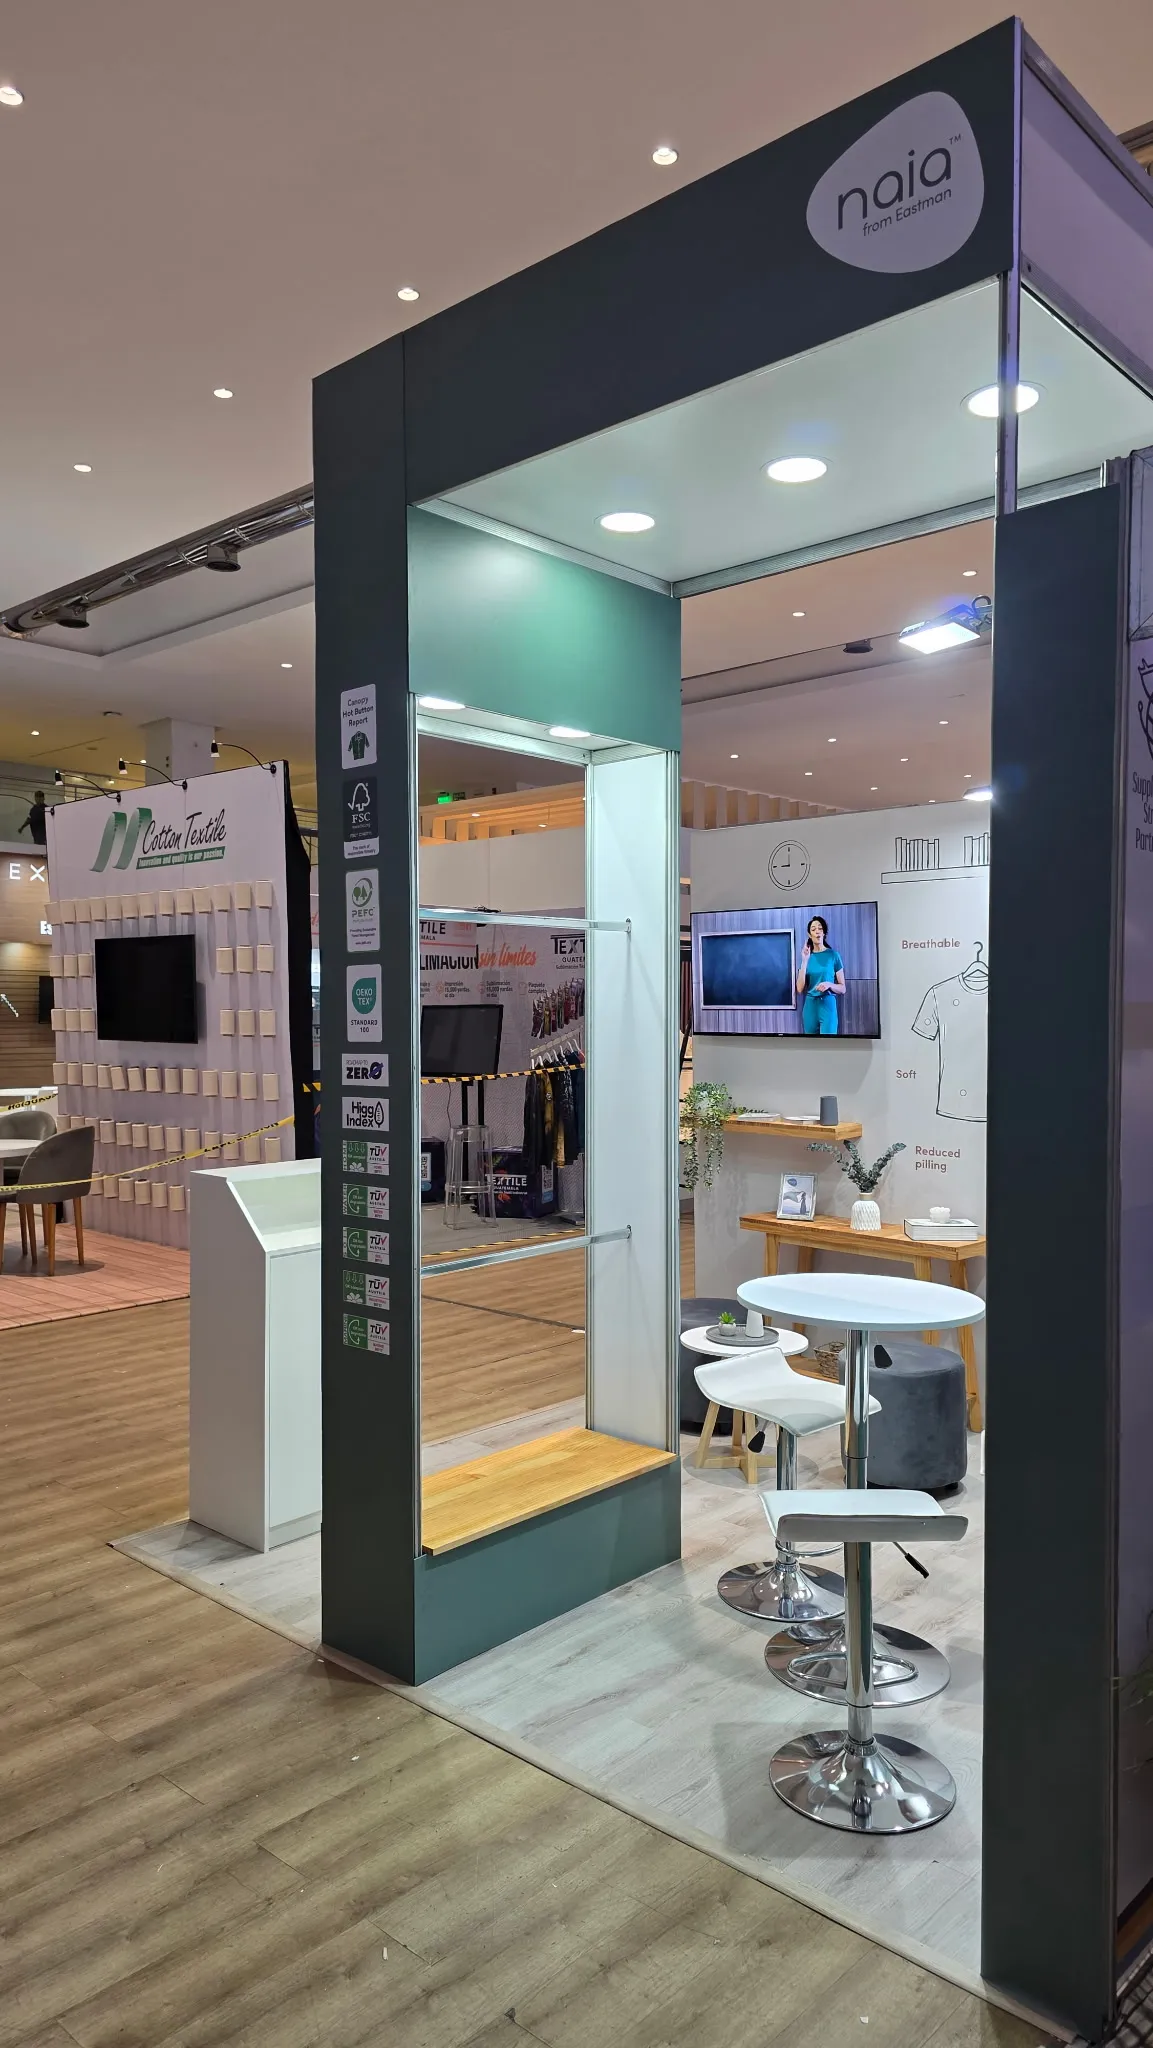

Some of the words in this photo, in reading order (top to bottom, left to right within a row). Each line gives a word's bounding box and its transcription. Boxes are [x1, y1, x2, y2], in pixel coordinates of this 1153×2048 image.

[863, 216, 893, 237] from
[895, 188, 952, 222] Eastman
[347, 696, 369, 707] Canopy
[342, 709, 354, 718] Hot
[354, 705, 374, 716] Button
[348, 716, 368, 728] Report
[351, 811, 371, 824] FSC
[142, 819, 182, 855] Cotton
[184, 808, 227, 849] Textile
[351, 908, 374, 918] PEFC
[901, 938, 961, 950] Breathable
[356, 988, 373, 996] OEKO
[346, 1061, 384, 1080] ZERO
[896, 1069, 917, 1080] Soft
[351, 1101, 374, 1118] Higg
[346, 1114, 374, 1128] Index
[915, 1145, 960, 1158] Reduced
[915, 1160, 948, 1173] pilling
